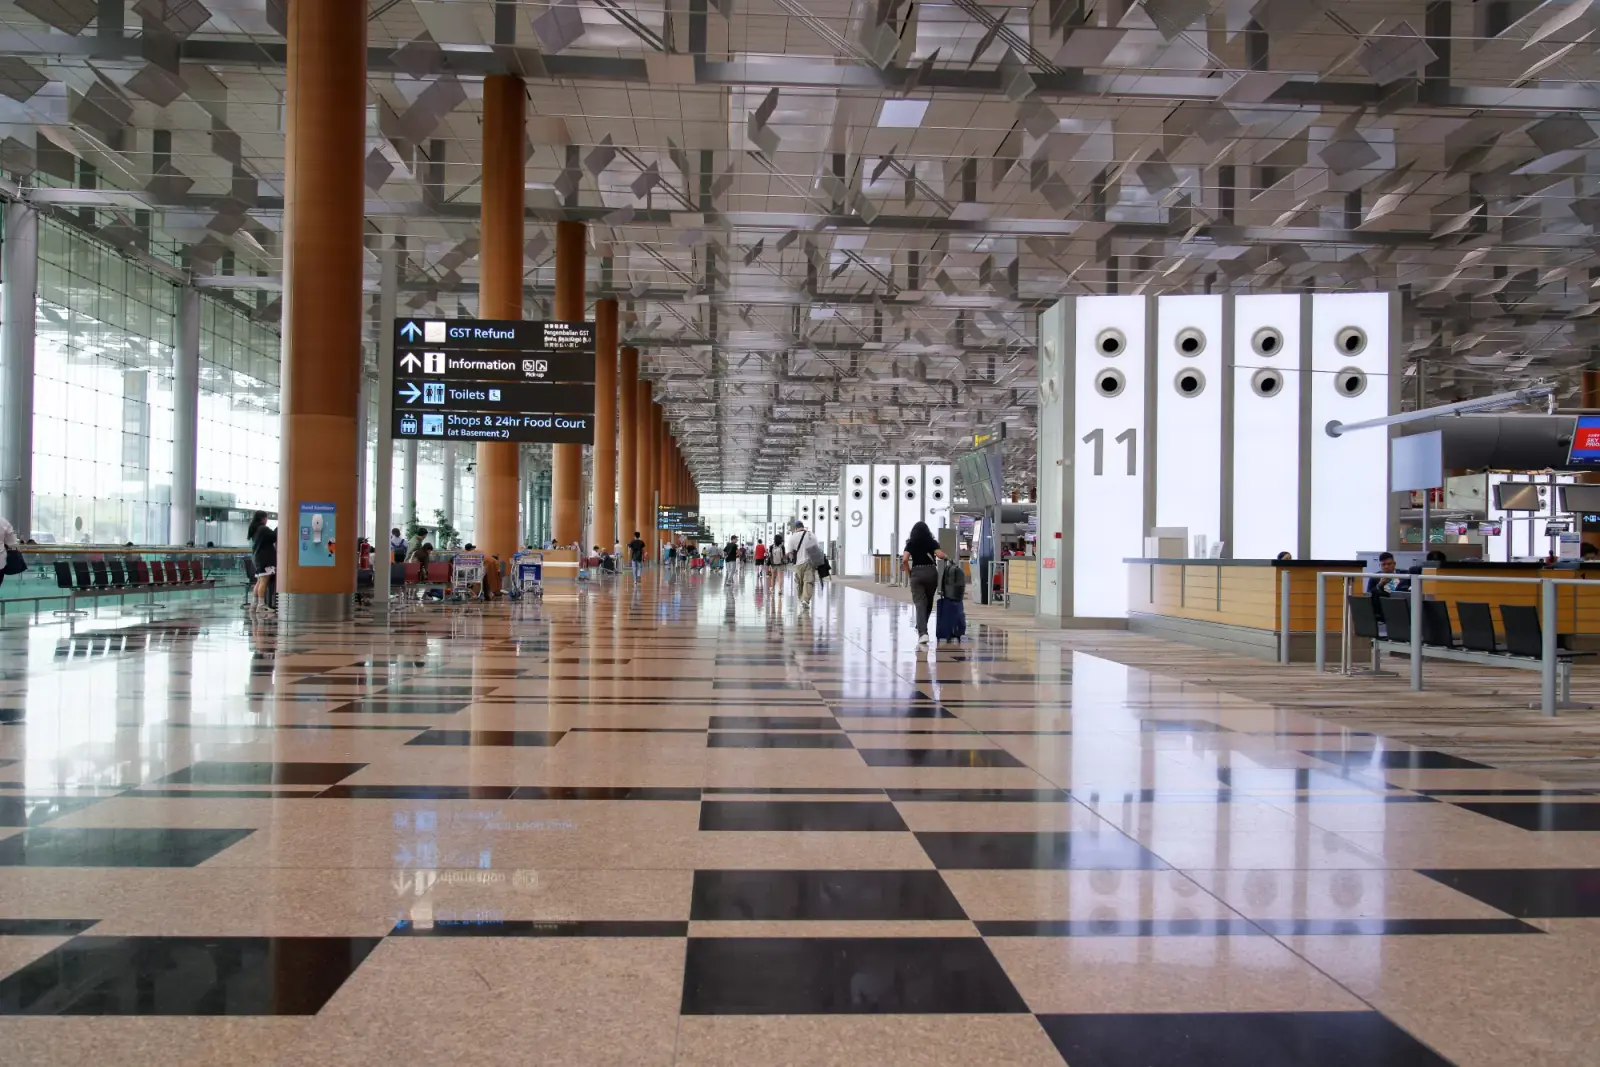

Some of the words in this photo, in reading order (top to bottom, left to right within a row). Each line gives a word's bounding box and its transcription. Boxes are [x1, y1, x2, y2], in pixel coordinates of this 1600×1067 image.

[449, 327, 471, 338] GST
[474, 328, 515, 339] Refund
[448, 358, 516, 370] Information
[525, 371, 545, 379] Pick-up
[449, 388, 485, 400] Toilets
[447, 415, 481, 427] Shops
[484, 416, 493, 426] &
[495, 416, 521, 427] 24hr
[524, 417, 552, 428] Food
[555, 417, 586, 429] Court
[447, 428, 460, 437] (at
[461, 428, 500, 438] Basement
[501, 430, 510, 438] 2)
[1081, 428, 1137, 476] 11
[850, 509, 863, 528] 9
